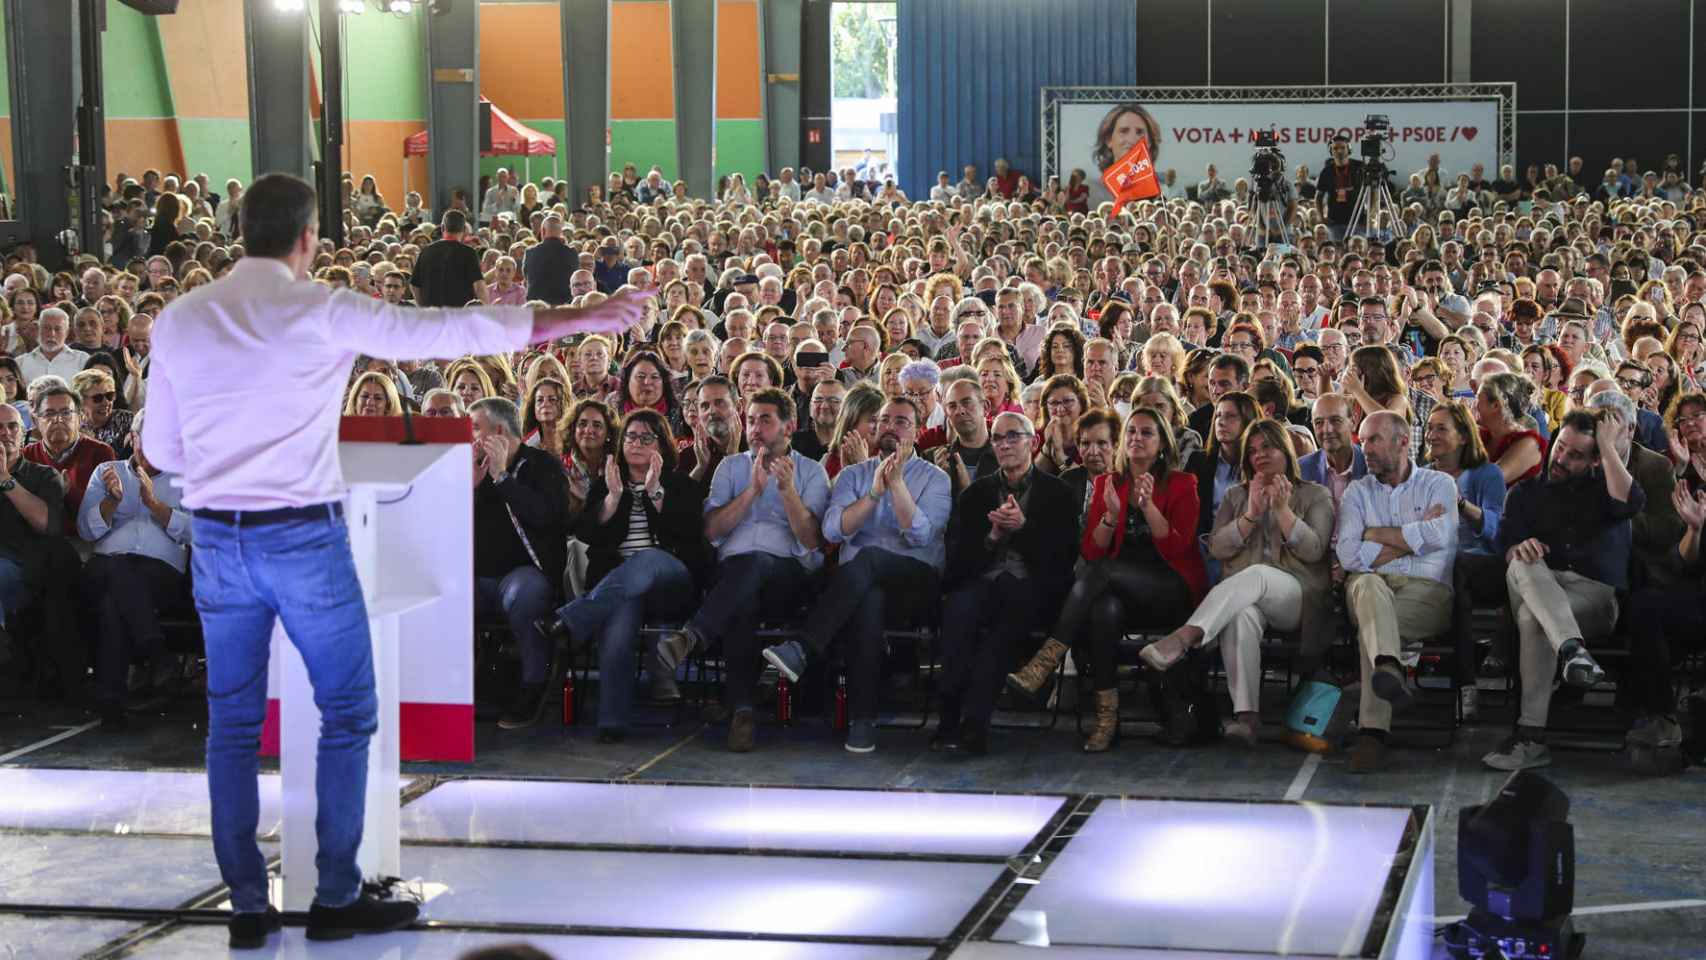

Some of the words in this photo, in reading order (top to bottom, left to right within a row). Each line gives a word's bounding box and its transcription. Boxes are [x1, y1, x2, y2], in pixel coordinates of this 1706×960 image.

[1172, 127, 1227, 144] VOTA
[1296, 127, 1381, 144] EUROP
[1403, 127, 1446, 143] PSOE
